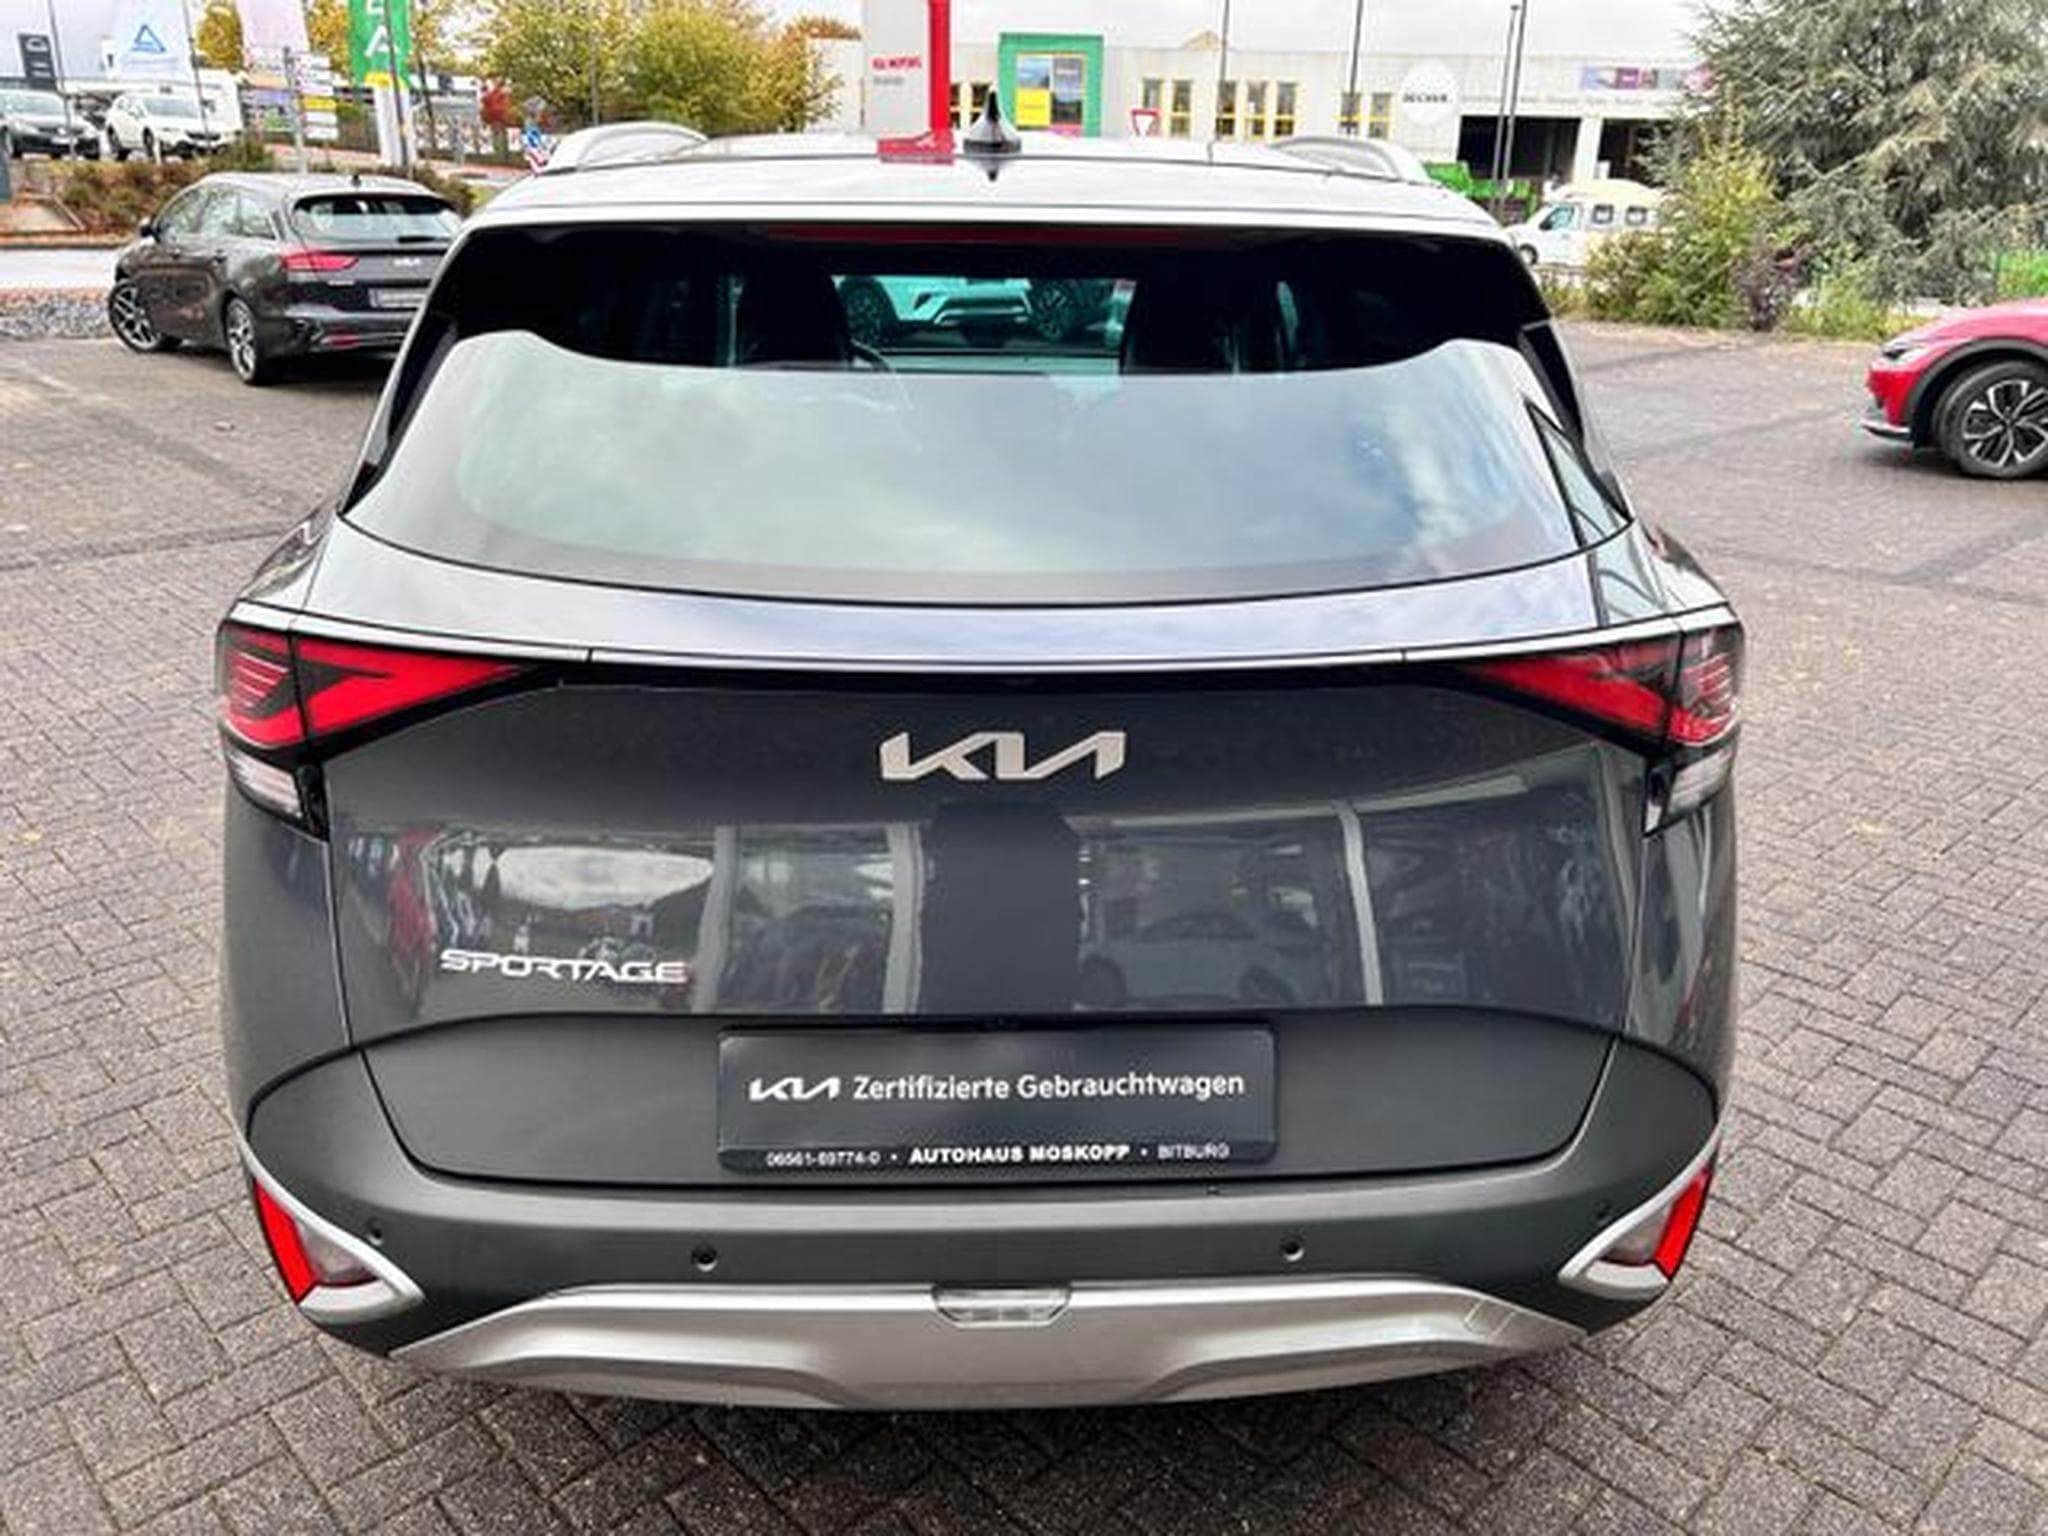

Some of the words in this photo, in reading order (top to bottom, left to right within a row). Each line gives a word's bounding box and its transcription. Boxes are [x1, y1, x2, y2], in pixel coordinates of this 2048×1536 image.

[880, 731, 1126, 780] KIA
[440, 948, 688, 984] SPORTAGE
[749, 1076, 841, 1100] KIA
[852, 1073, 1009, 1100] Zertifizierte
[1017, 1070, 1245, 1101] Gebrauchtwagen
[909, 1147, 1024, 1165] AUTOHAUS
[1029, 1144, 1131, 1163] MOSKOPP
[1157, 1142, 1231, 1160] BITBURG
